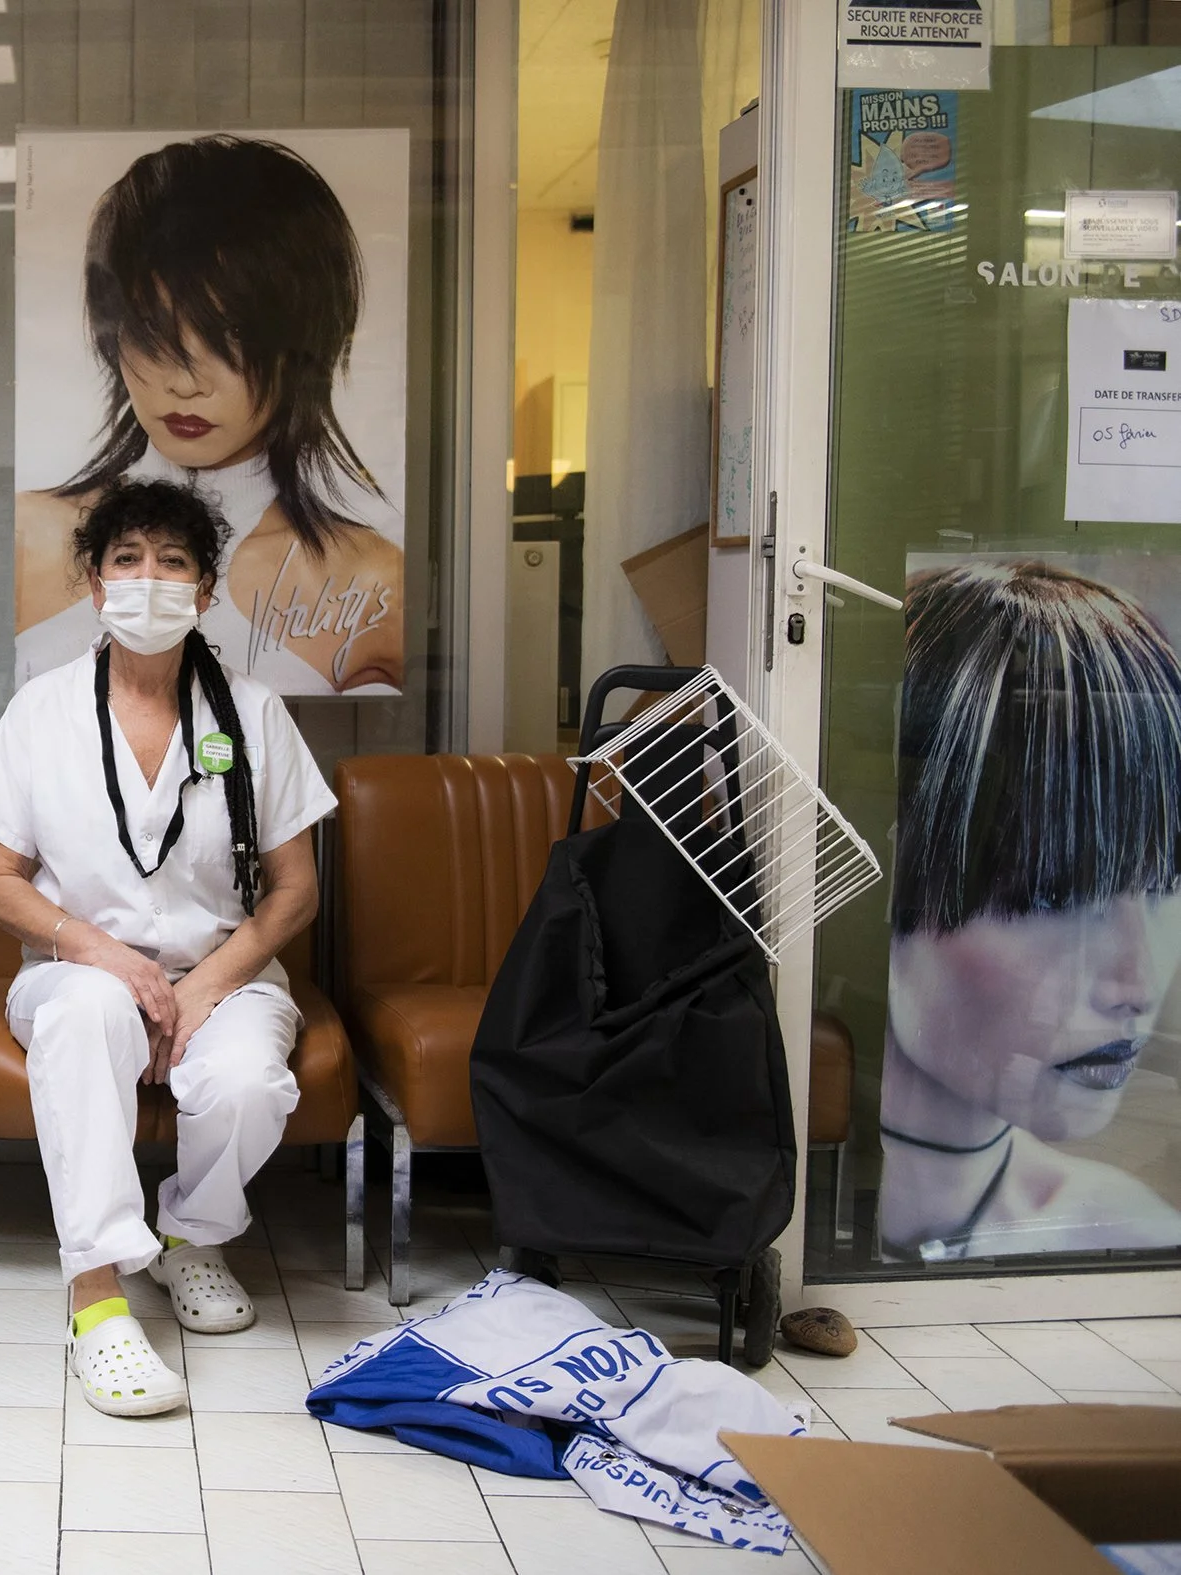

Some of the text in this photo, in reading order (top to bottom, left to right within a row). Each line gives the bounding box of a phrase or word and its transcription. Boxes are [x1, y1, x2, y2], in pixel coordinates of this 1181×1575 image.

[847, 9, 983, 25] SECURITE RENFORCEE
[860, 25, 969, 39] RISQUE ATTENTAT
[861, 91, 903, 105] MISSION
[861, 95, 939, 121] MAINS
[862, 116, 927, 132] PROPRES
[976, 261, 1080, 287] SALON
[1094, 390, 1119, 399] DATE
[1121, 390, 1133, 400] DE
[552, 1331, 663, 1385] LYON
